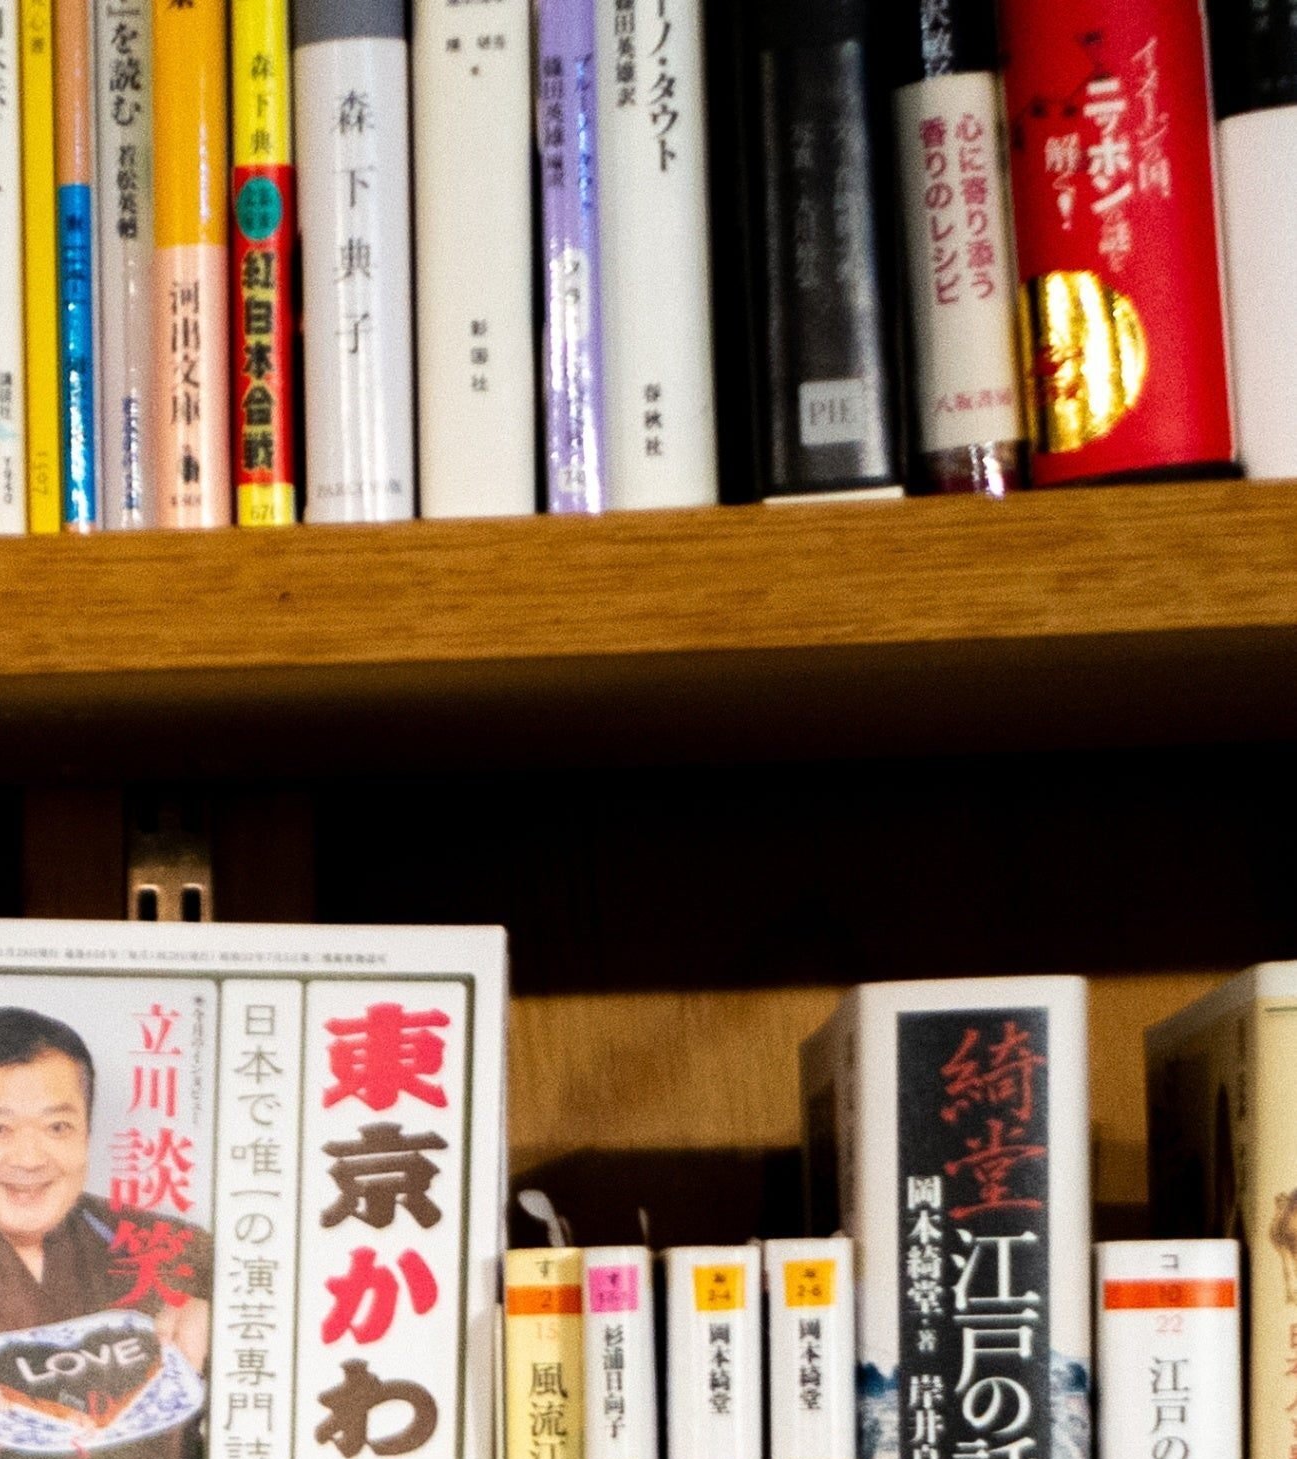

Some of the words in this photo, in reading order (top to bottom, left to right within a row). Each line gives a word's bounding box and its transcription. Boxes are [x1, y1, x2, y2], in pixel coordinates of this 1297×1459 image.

[330, 87, 374, 356] 森下典子
[170, 280, 201, 426] 河出文庫
[107, 1002, 196, 1308] 立川談笑
[940, 1019, 1047, 1221] 綺堂
[14, 1337, 147, 1385] LOVE
[603, 1322, 628, 1440] 杉浦日向子
